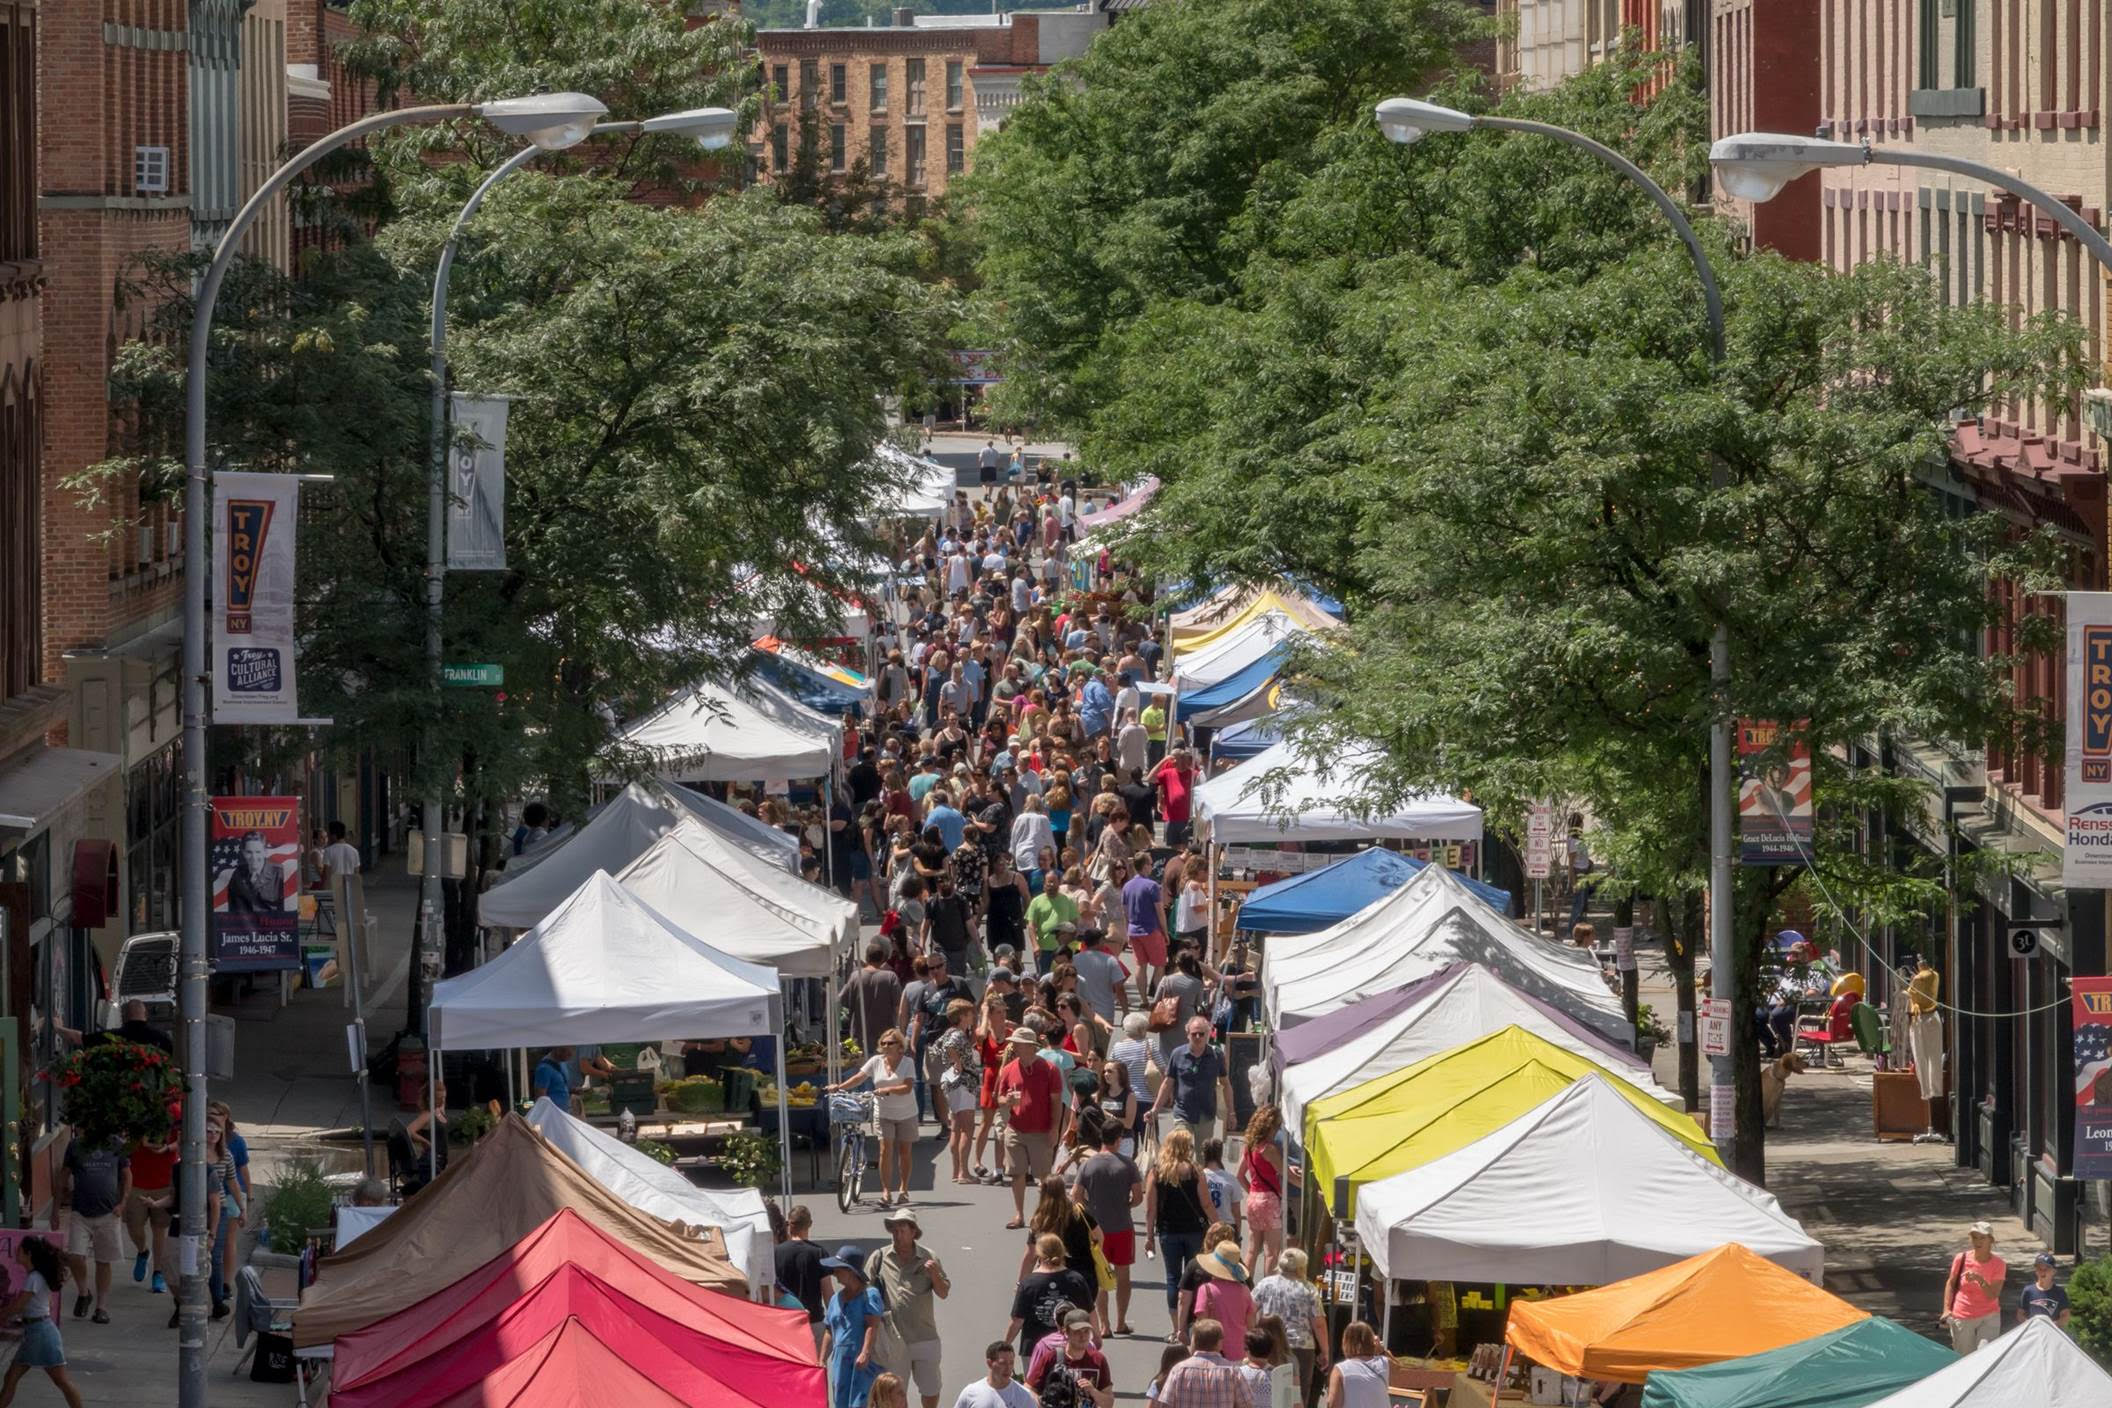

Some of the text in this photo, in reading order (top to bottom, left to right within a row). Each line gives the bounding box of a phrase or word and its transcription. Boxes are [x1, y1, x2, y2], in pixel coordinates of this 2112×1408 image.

[233, 512, 250, 592] TROY
[231, 618, 247, 629] NY
[231, 659, 277, 675] CULTURAL
[236, 667, 277, 687] ALLIANCE
[444, 668, 488, 681] FRANKLIN
[2091, 640, 2112, 734] TROY
[2087, 765, 2106, 777] NY
[2069, 832, 2112, 846] Hond
[221, 931, 293, 947] James Lucia Sr.
[240, 945, 276, 955] 1946-1947
[1709, 1020, 1722, 1031] ANY
